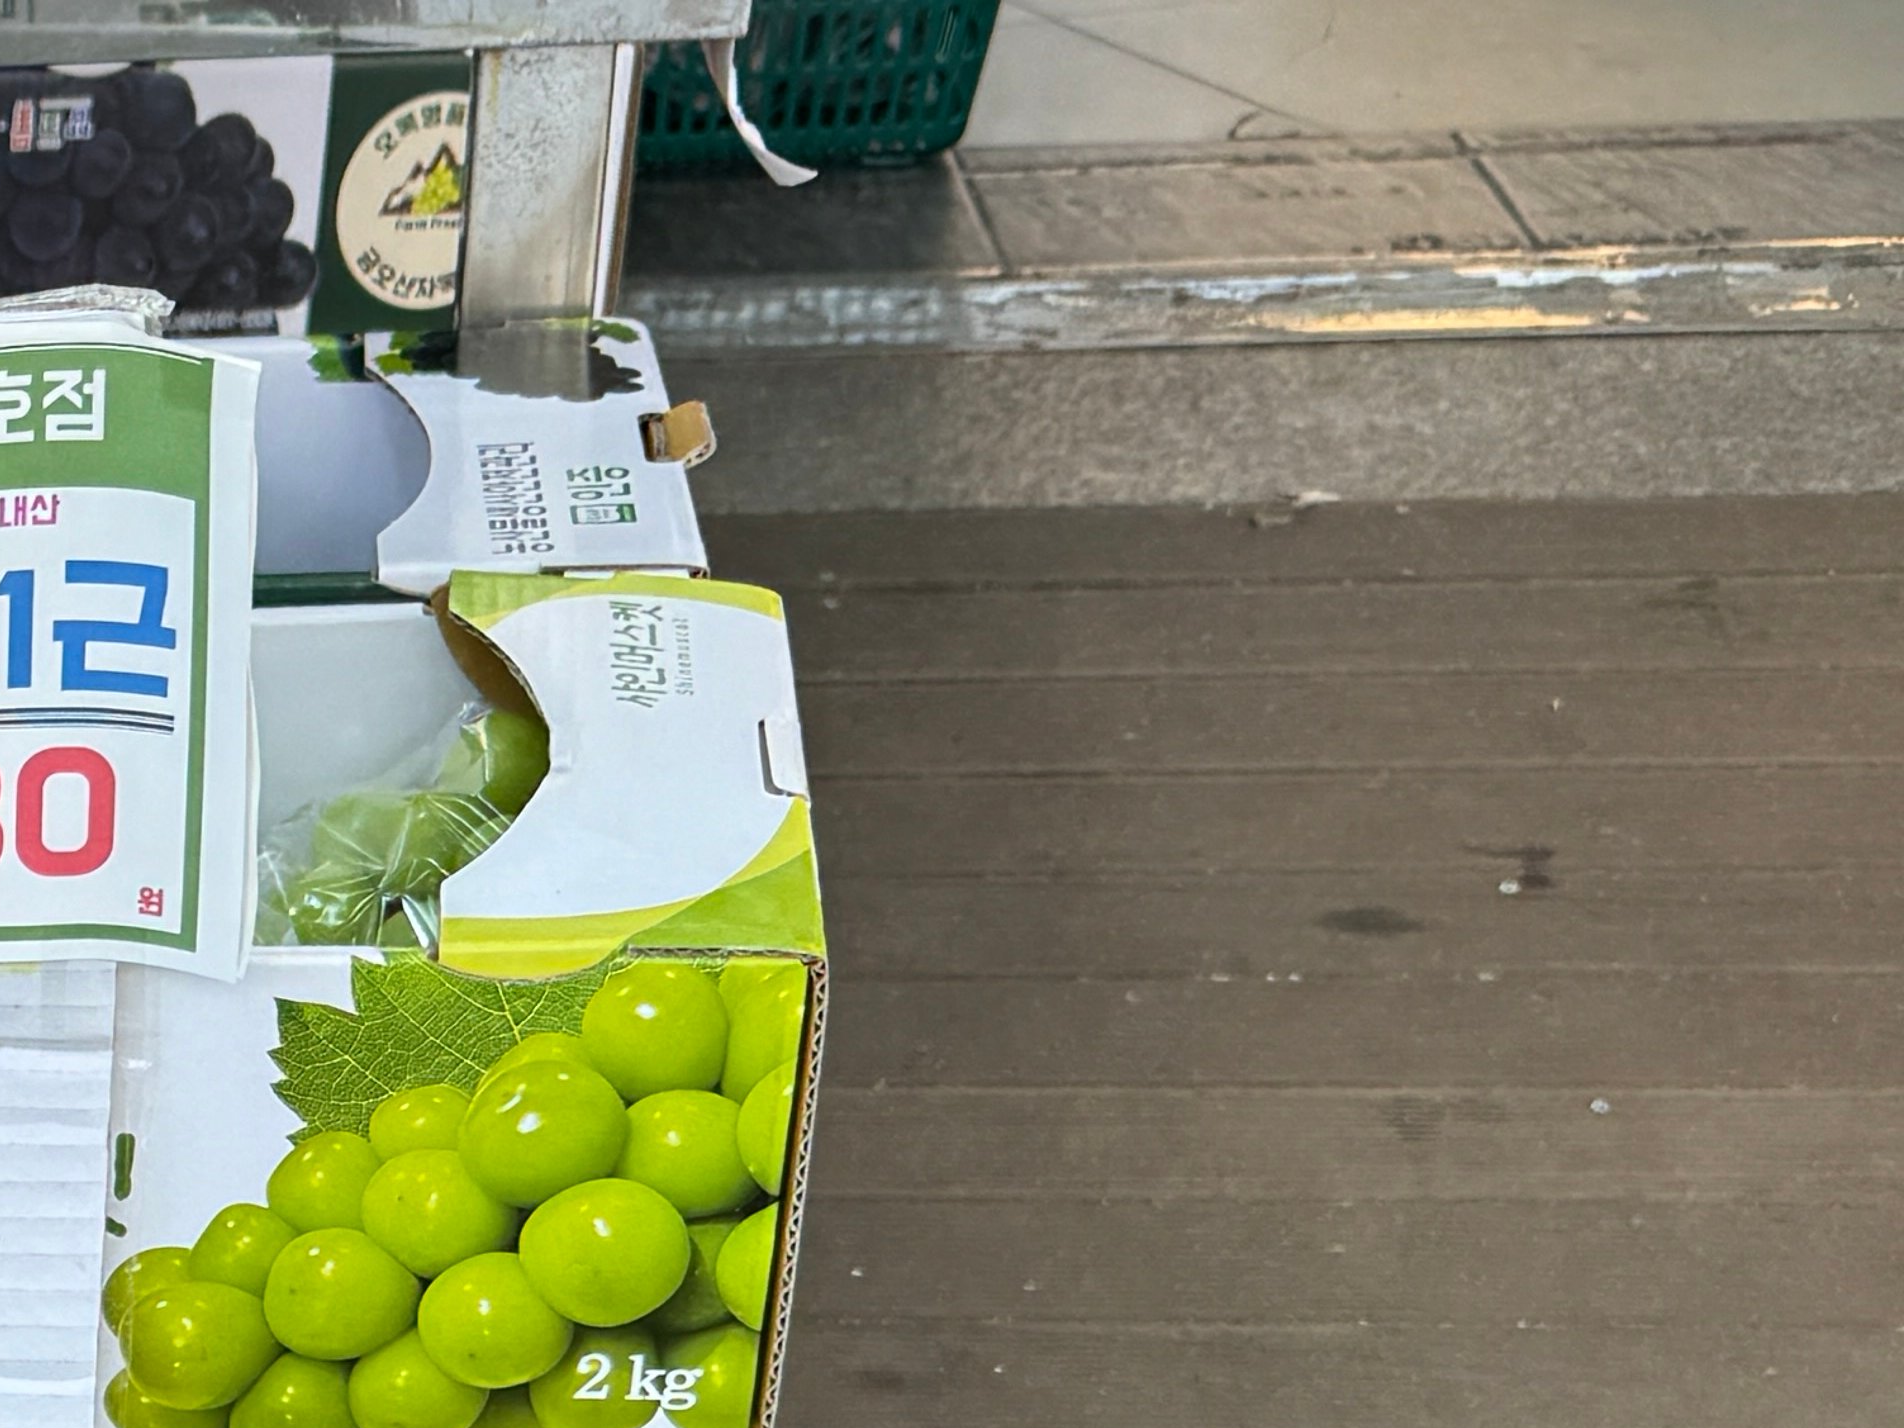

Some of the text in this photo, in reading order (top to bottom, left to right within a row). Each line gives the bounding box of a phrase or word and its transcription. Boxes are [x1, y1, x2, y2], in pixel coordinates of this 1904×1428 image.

[566, 465, 631, 500] 인증
[608, 600, 668, 709] 샤인머스켓
[137, 885, 165, 918] 원
[572, 1352, 705, 1412] 2 kg
